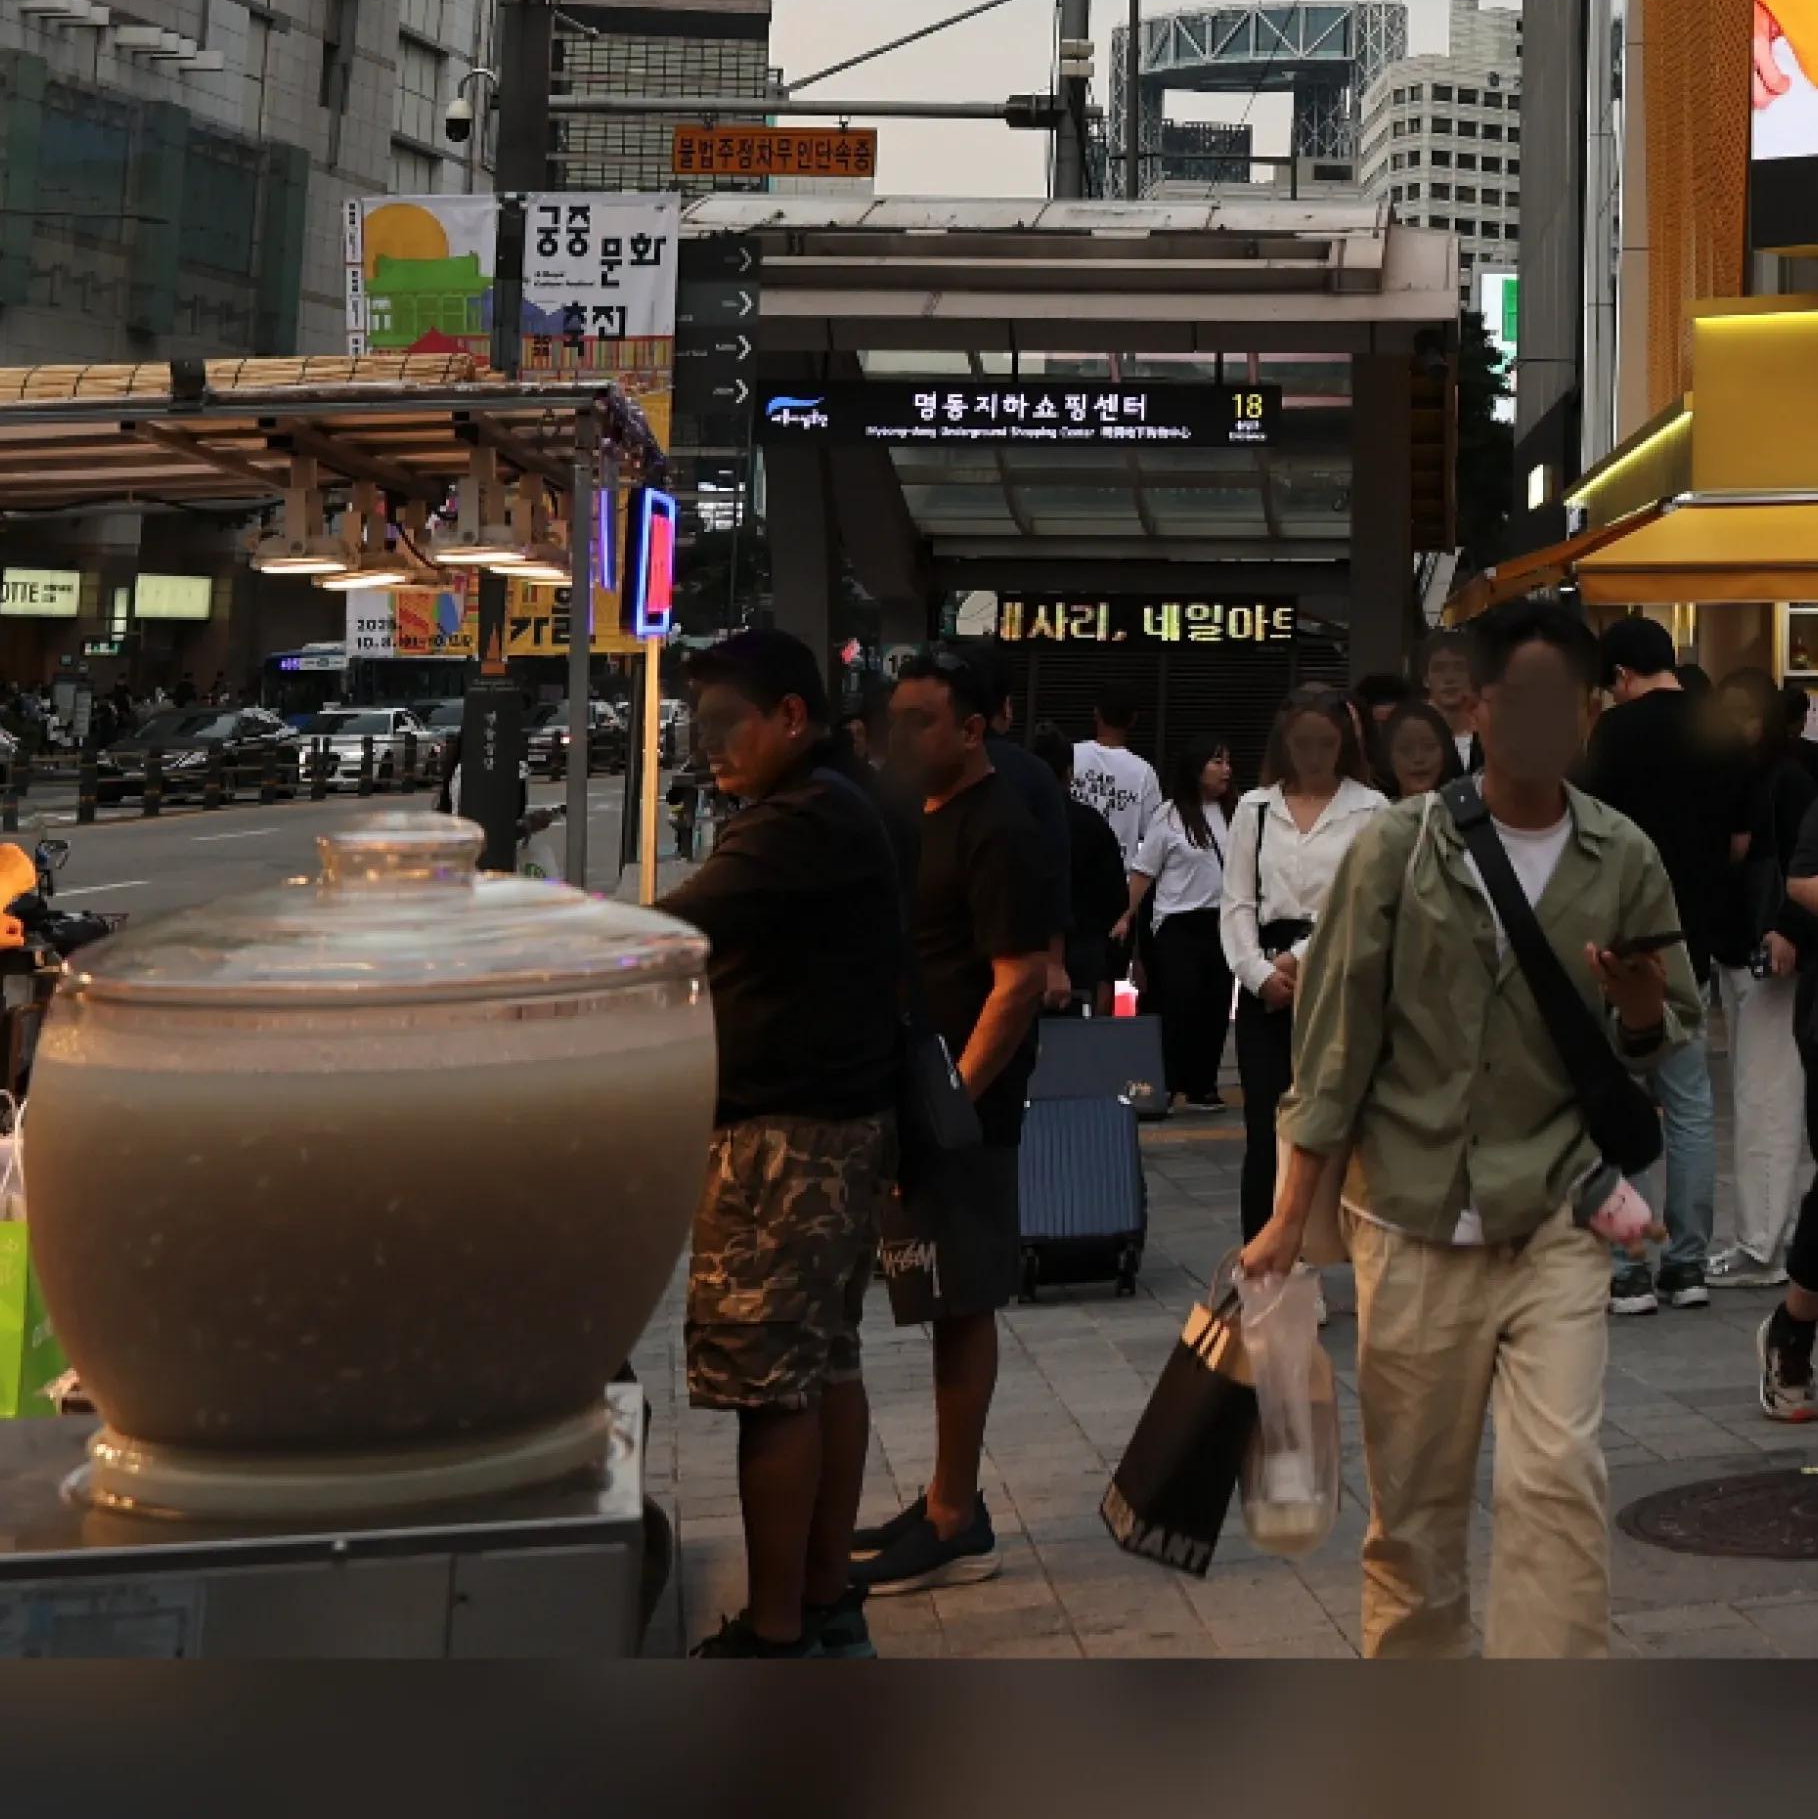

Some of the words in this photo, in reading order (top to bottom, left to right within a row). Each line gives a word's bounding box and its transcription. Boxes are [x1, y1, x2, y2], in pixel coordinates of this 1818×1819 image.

[677, 137, 871, 172] 불법주정차무인단속중
[600, 232, 667, 288] 문화
[914, 390, 1148, 422] 명동지하쇼핑센터
[1231, 393, 1264, 419] 18
